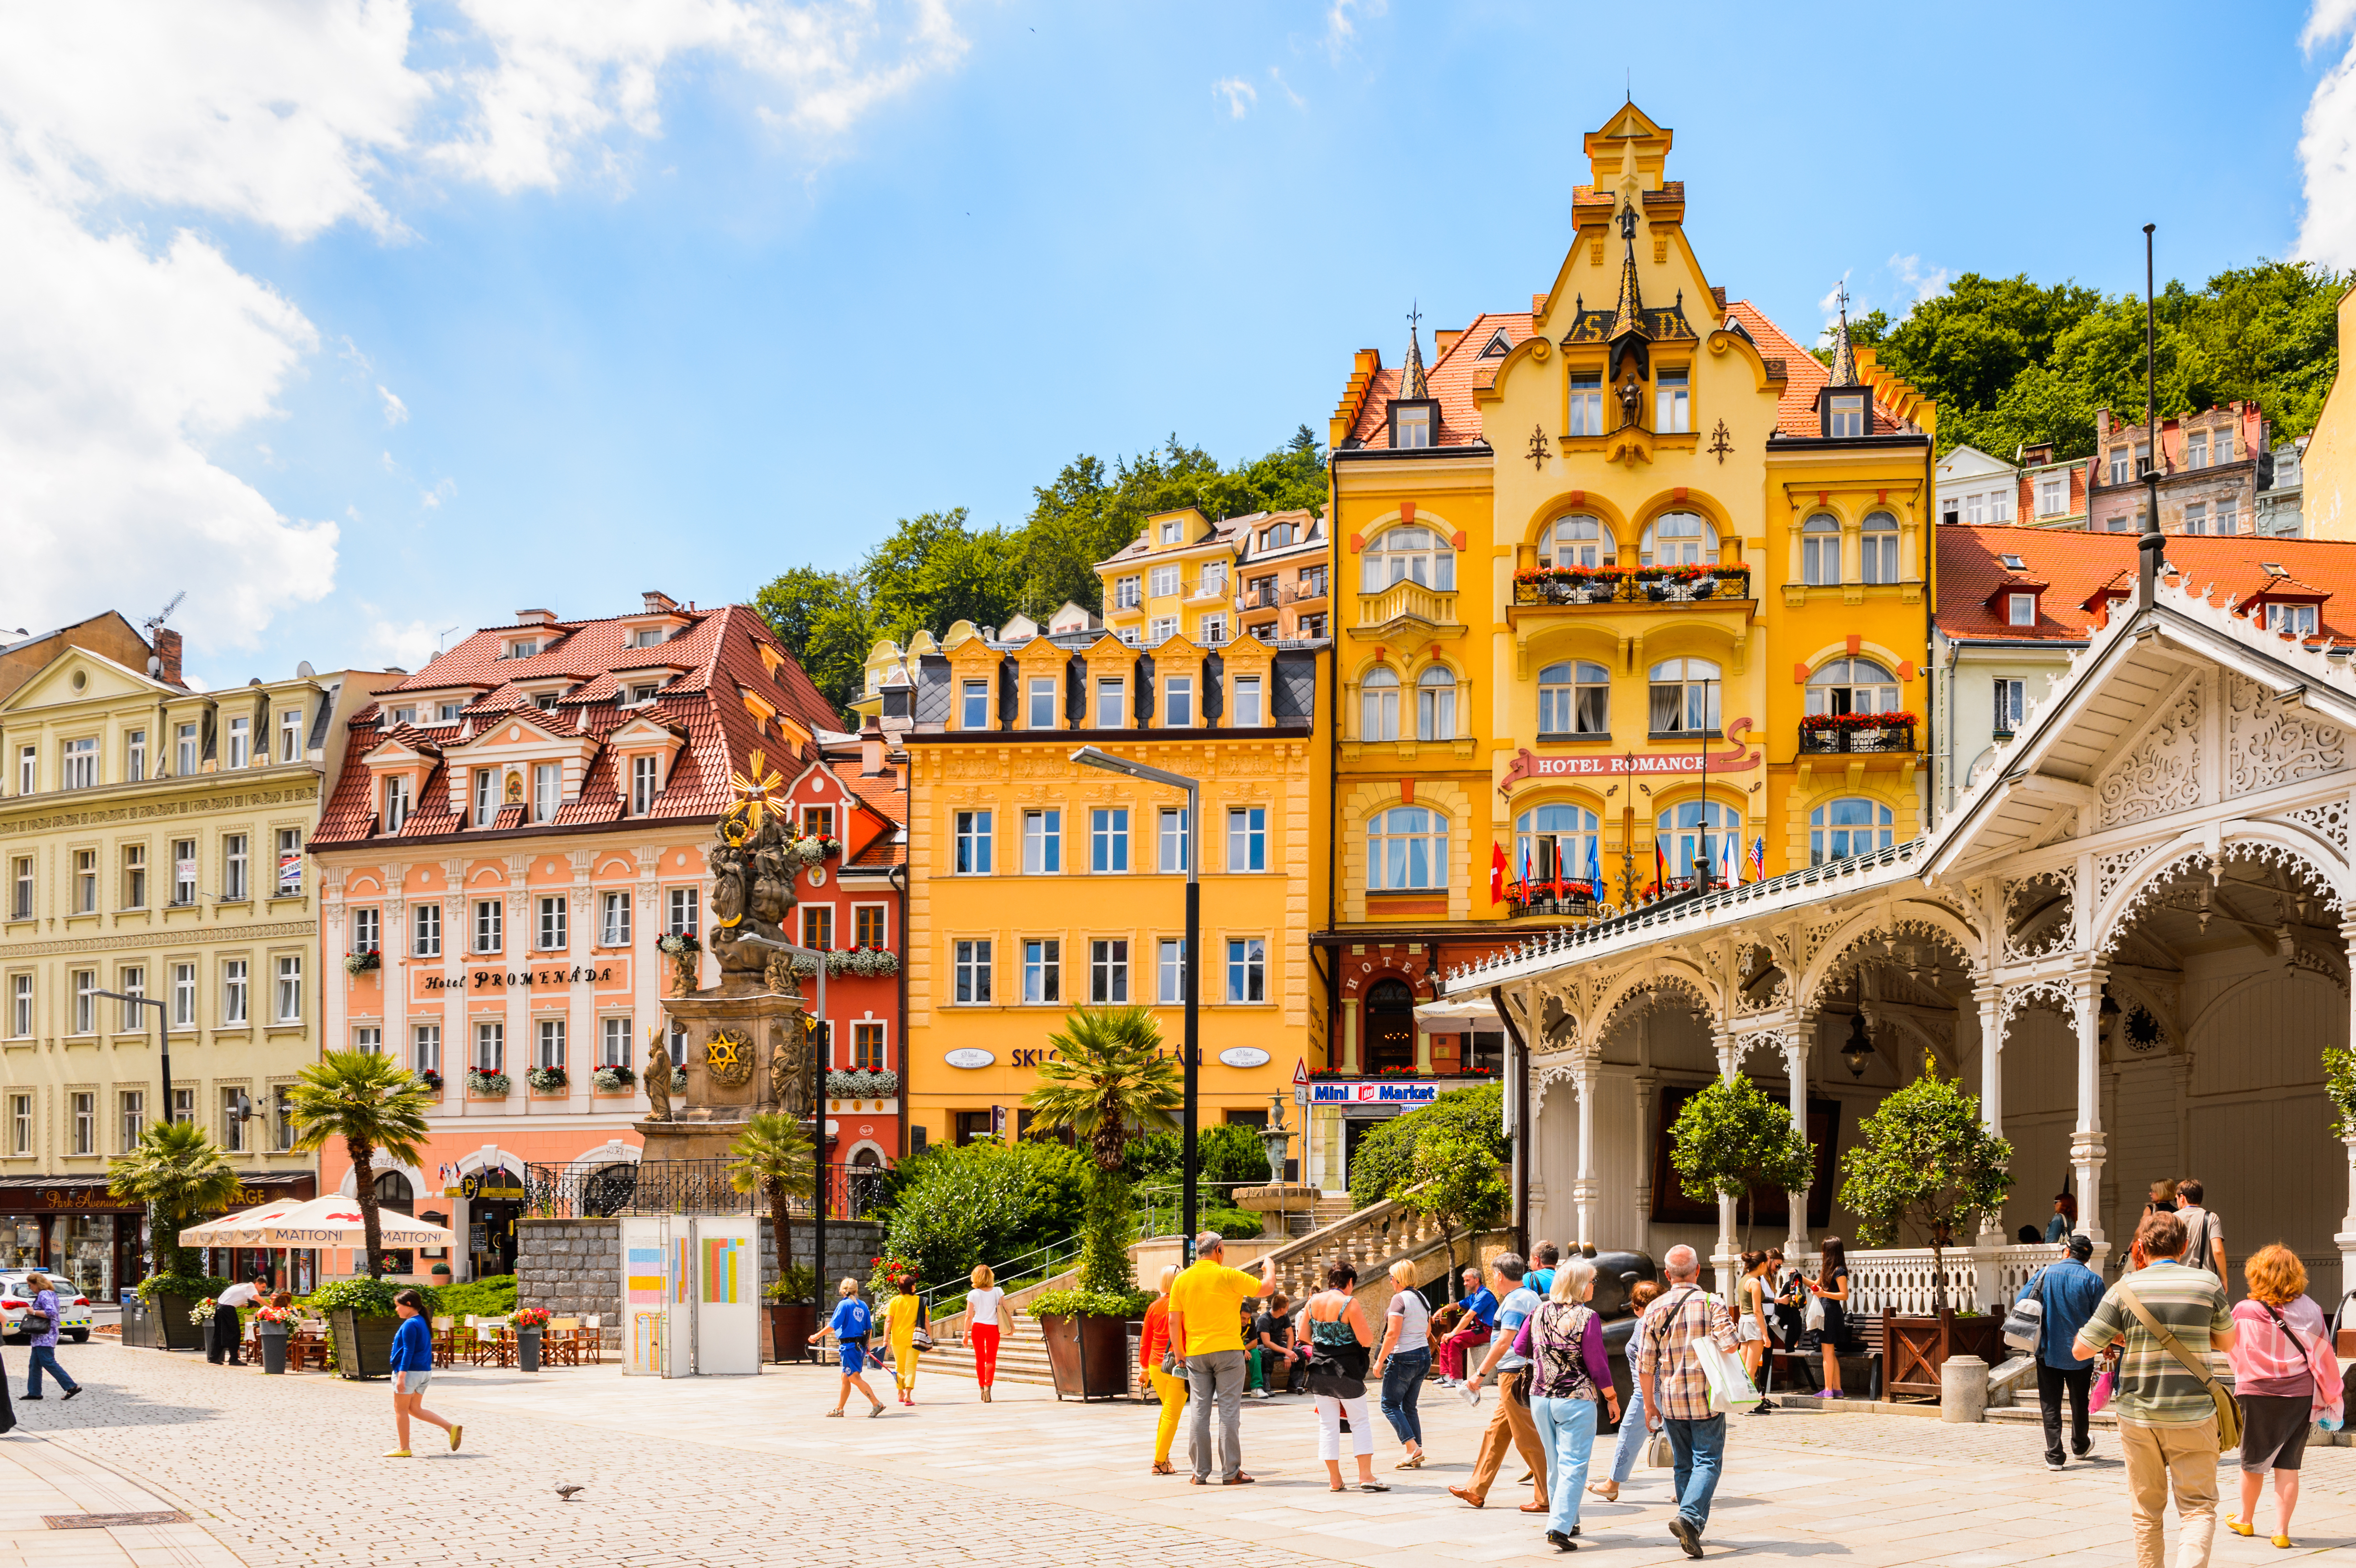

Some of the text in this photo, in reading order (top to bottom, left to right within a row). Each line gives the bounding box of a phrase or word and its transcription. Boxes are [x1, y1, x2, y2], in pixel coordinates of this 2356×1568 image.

[1538, 756, 1707, 773] HOTEL ROMANCE
[425, 966, 611, 989] Hotel PROMENÁDA
[1346, 957, 1425, 990] HOTEL
[1298, 1091, 1301, 1100] 2
[1315, 1085, 1435, 1100] Mini Market
[464, 1178, 475, 1195] P
[47, 1190, 118, 1209] Park Avenue
[275, 1230, 342, 1241] MATTONI
[381, 1231, 442, 1242] MATTONI
